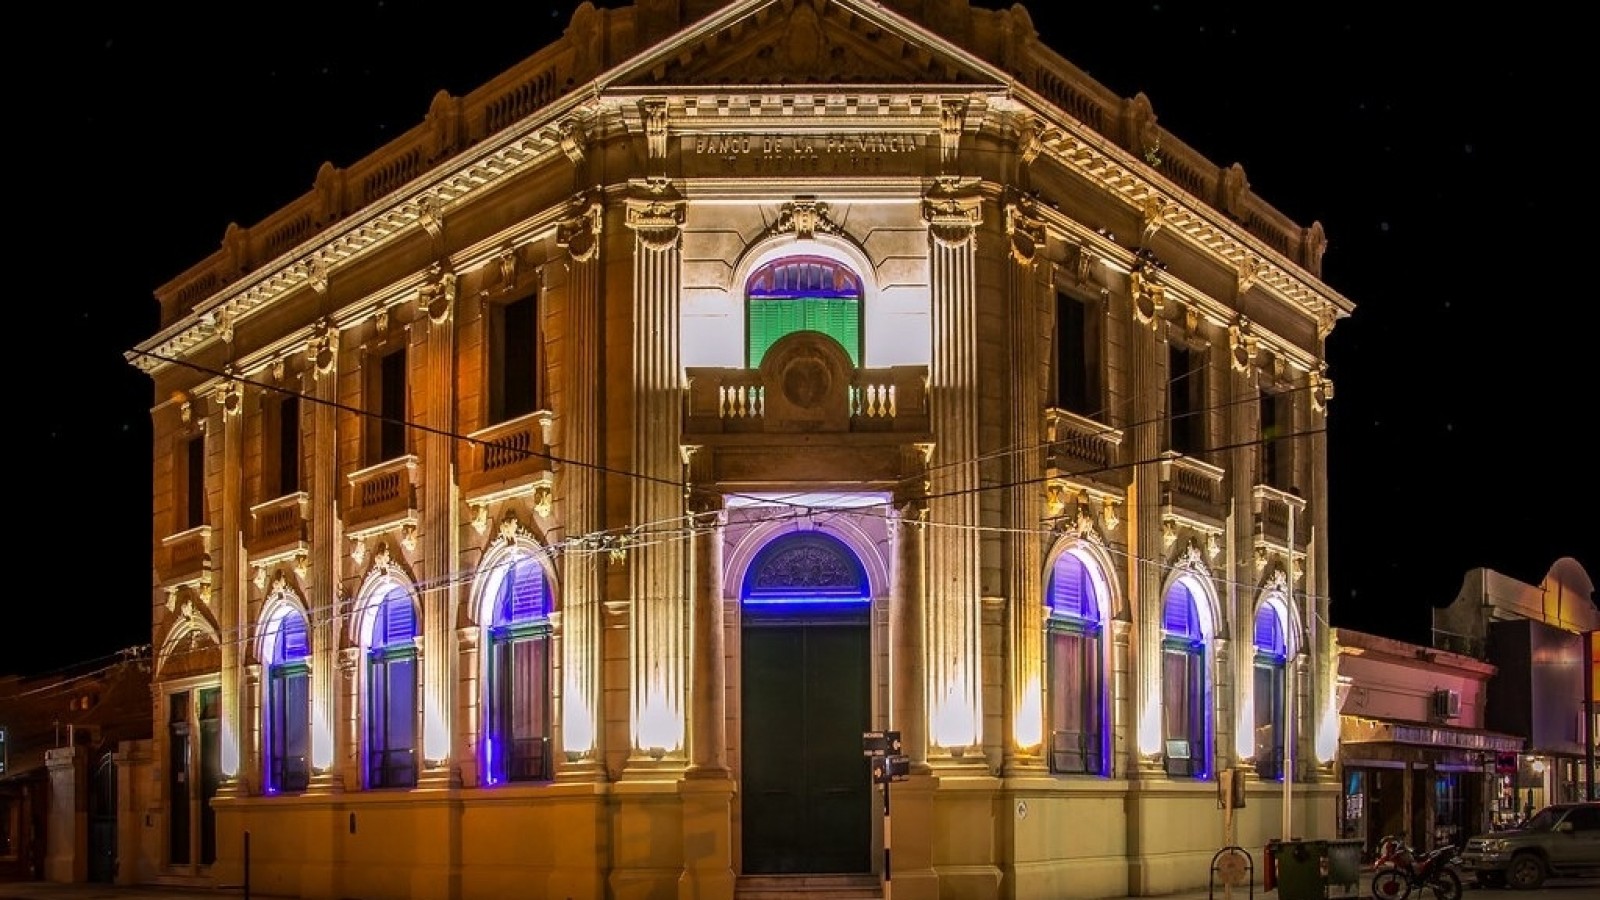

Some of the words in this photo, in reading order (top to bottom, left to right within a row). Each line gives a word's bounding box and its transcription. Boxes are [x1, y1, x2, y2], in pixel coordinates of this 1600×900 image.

[696, 138, 750, 154] BANCO
[763, 138, 782, 154] DE
[794, 138, 814, 154] LA
[827, 138, 917, 154] PRVINCIA
